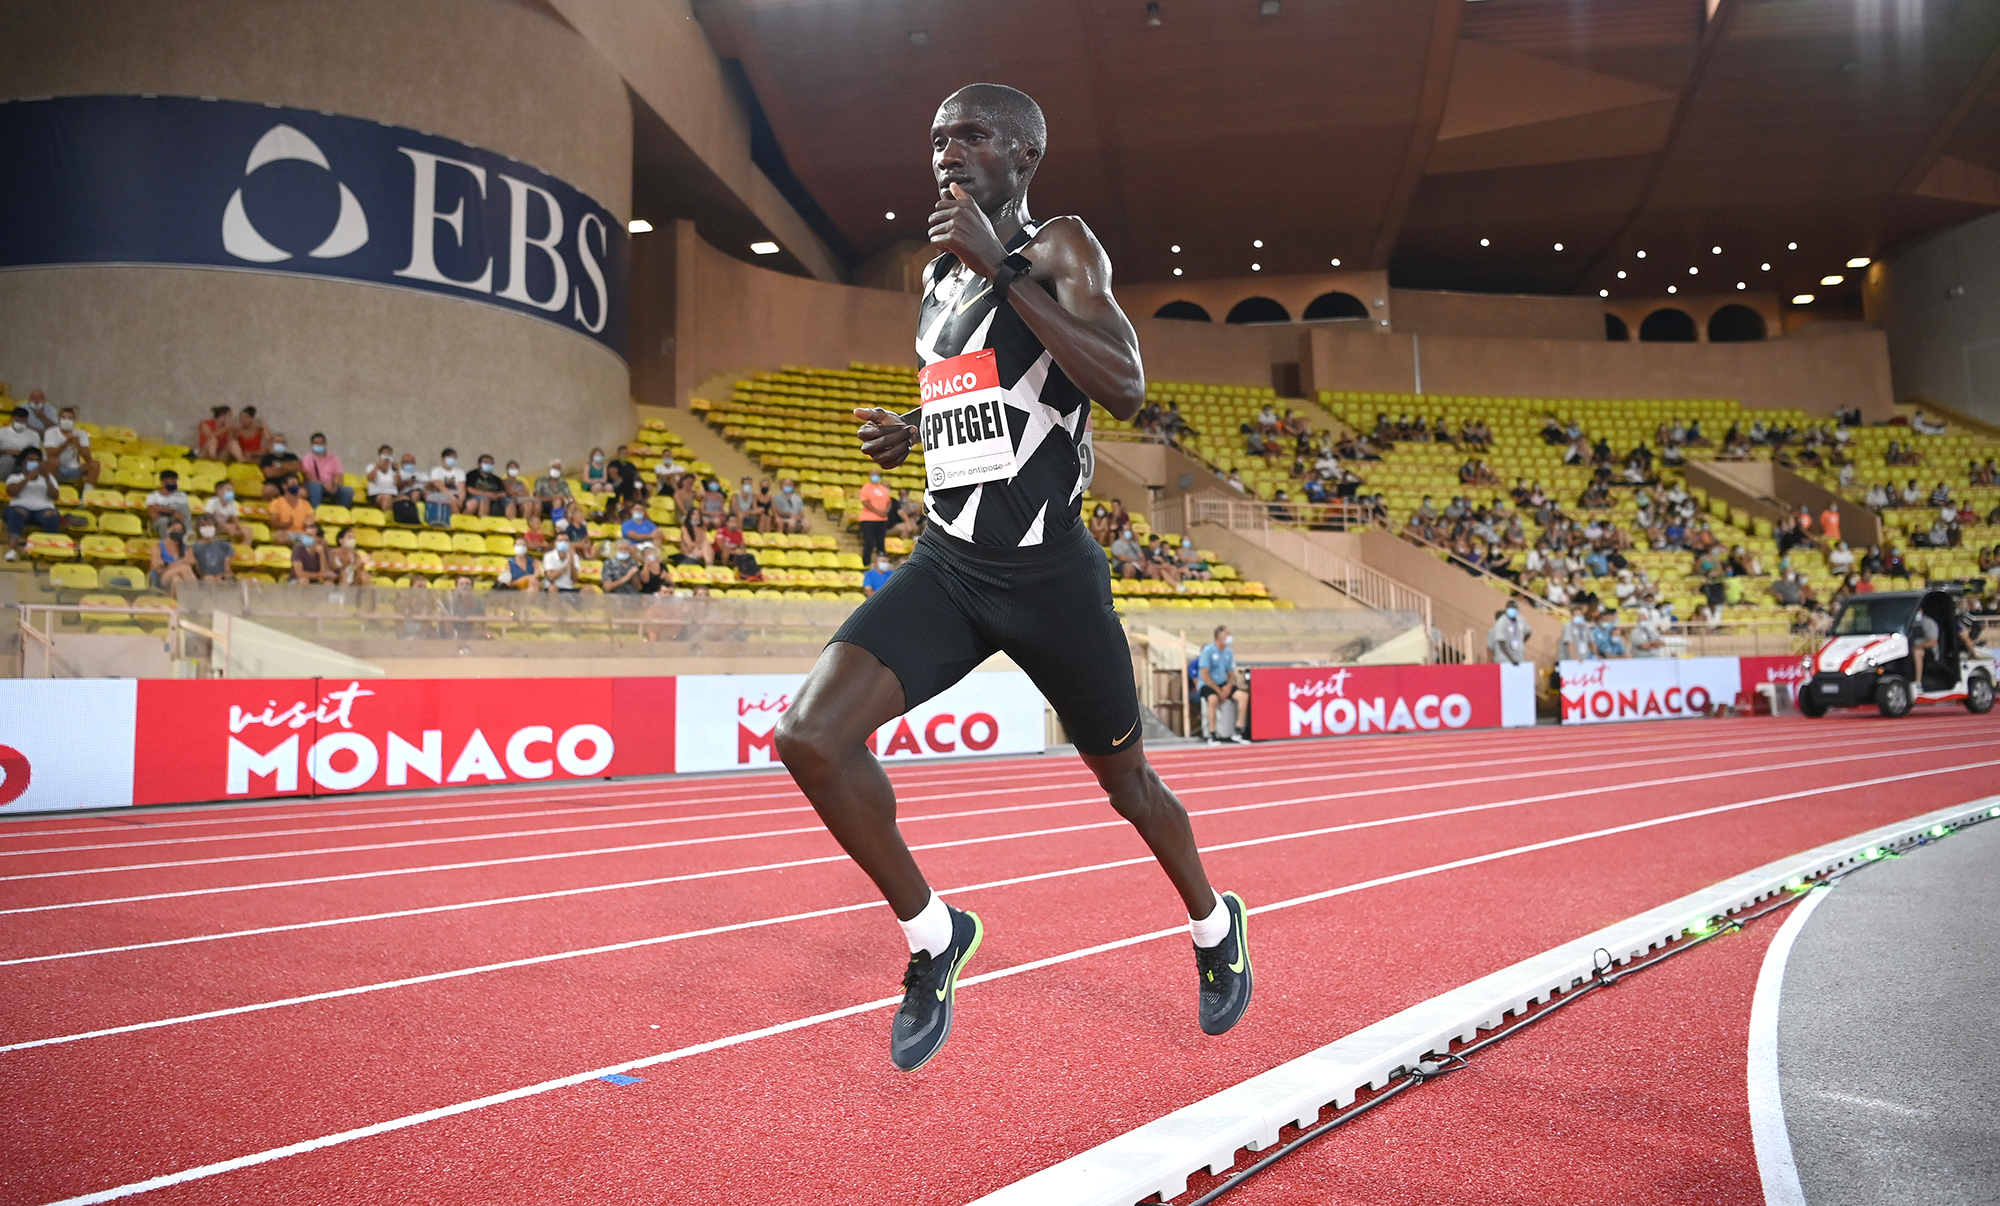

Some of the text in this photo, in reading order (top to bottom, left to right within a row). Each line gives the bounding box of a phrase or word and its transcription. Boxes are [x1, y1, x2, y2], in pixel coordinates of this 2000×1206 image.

[393, 146, 608, 333] EBS
[968, 462, 1004, 476] antipode
[1289, 668, 1353, 700] visit
[1560, 664, 1609, 688] visit
[229, 681, 375, 733] visit
[738, 693, 791, 716] vis
[1289, 693, 1471, 736] MONACO
[1560, 686, 1710, 720] MONACO
[737, 712, 998, 764] MACO
[226, 724, 614, 794] MONACO
